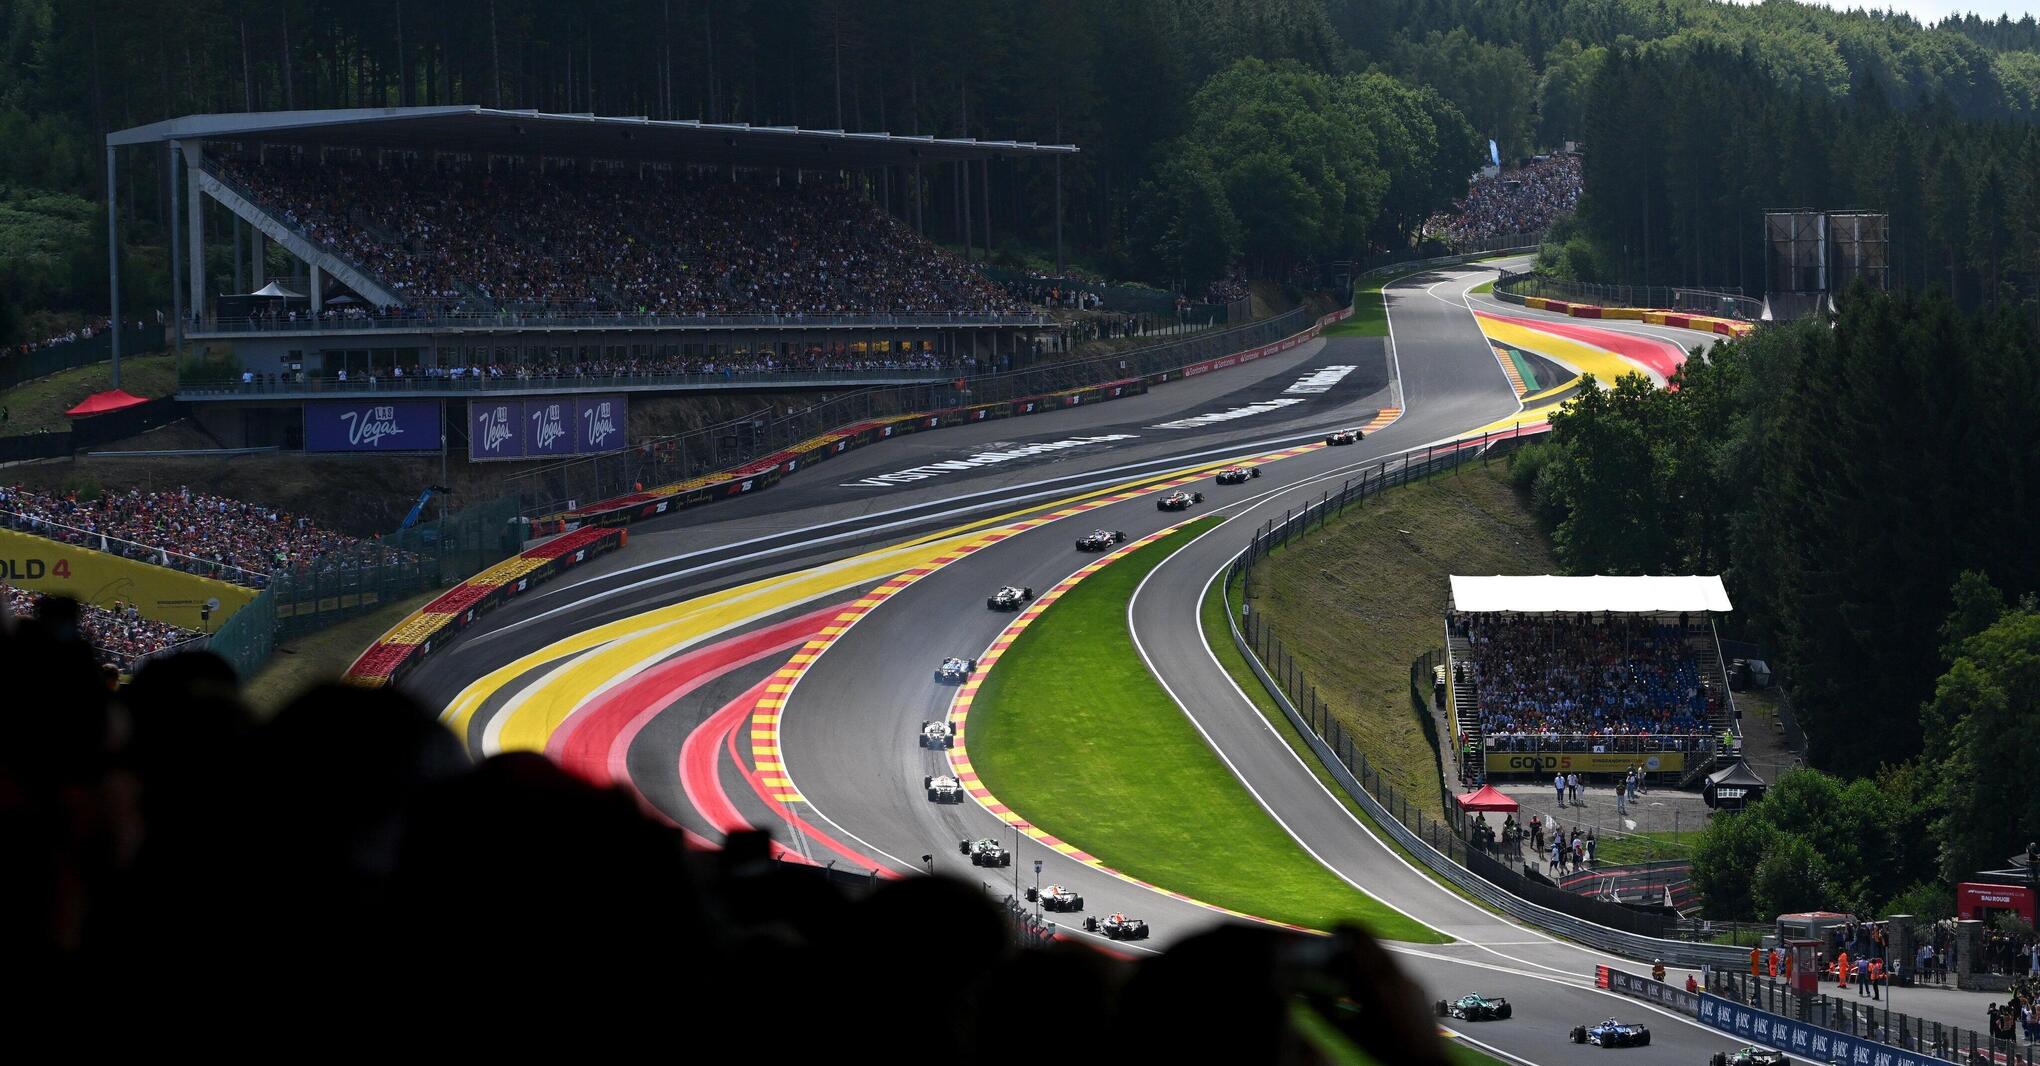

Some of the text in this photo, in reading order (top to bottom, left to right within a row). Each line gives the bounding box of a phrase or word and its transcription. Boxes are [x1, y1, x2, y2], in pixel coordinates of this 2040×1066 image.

[1189, 365, 1209, 376] Santander
[375, 406, 394, 421] LAS
[341, 409, 404, 447] Vegas
[480, 409, 513, 452] Vegas
[532, 407, 566, 450] Vegas
[584, 405, 616, 447] Vegas
[52, 558, 71, 580] 4
[1510, 756, 1571, 769] GOD 5
[1704, 1000, 1714, 1017] MSC
[1721, 1006, 1731, 1023] MSC
[1740, 1012, 1750, 1029] MSC
[1758, 1018, 1768, 1035] MSC
[1777, 1023, 1788, 1041] MSC
[1797, 1029, 1807, 1046] MSC
[1817, 1034, 1828, 1053] MSC
[1837, 1040, 1849, 1058] MSC
[1859, 1046, 1870, 1065] MSC
